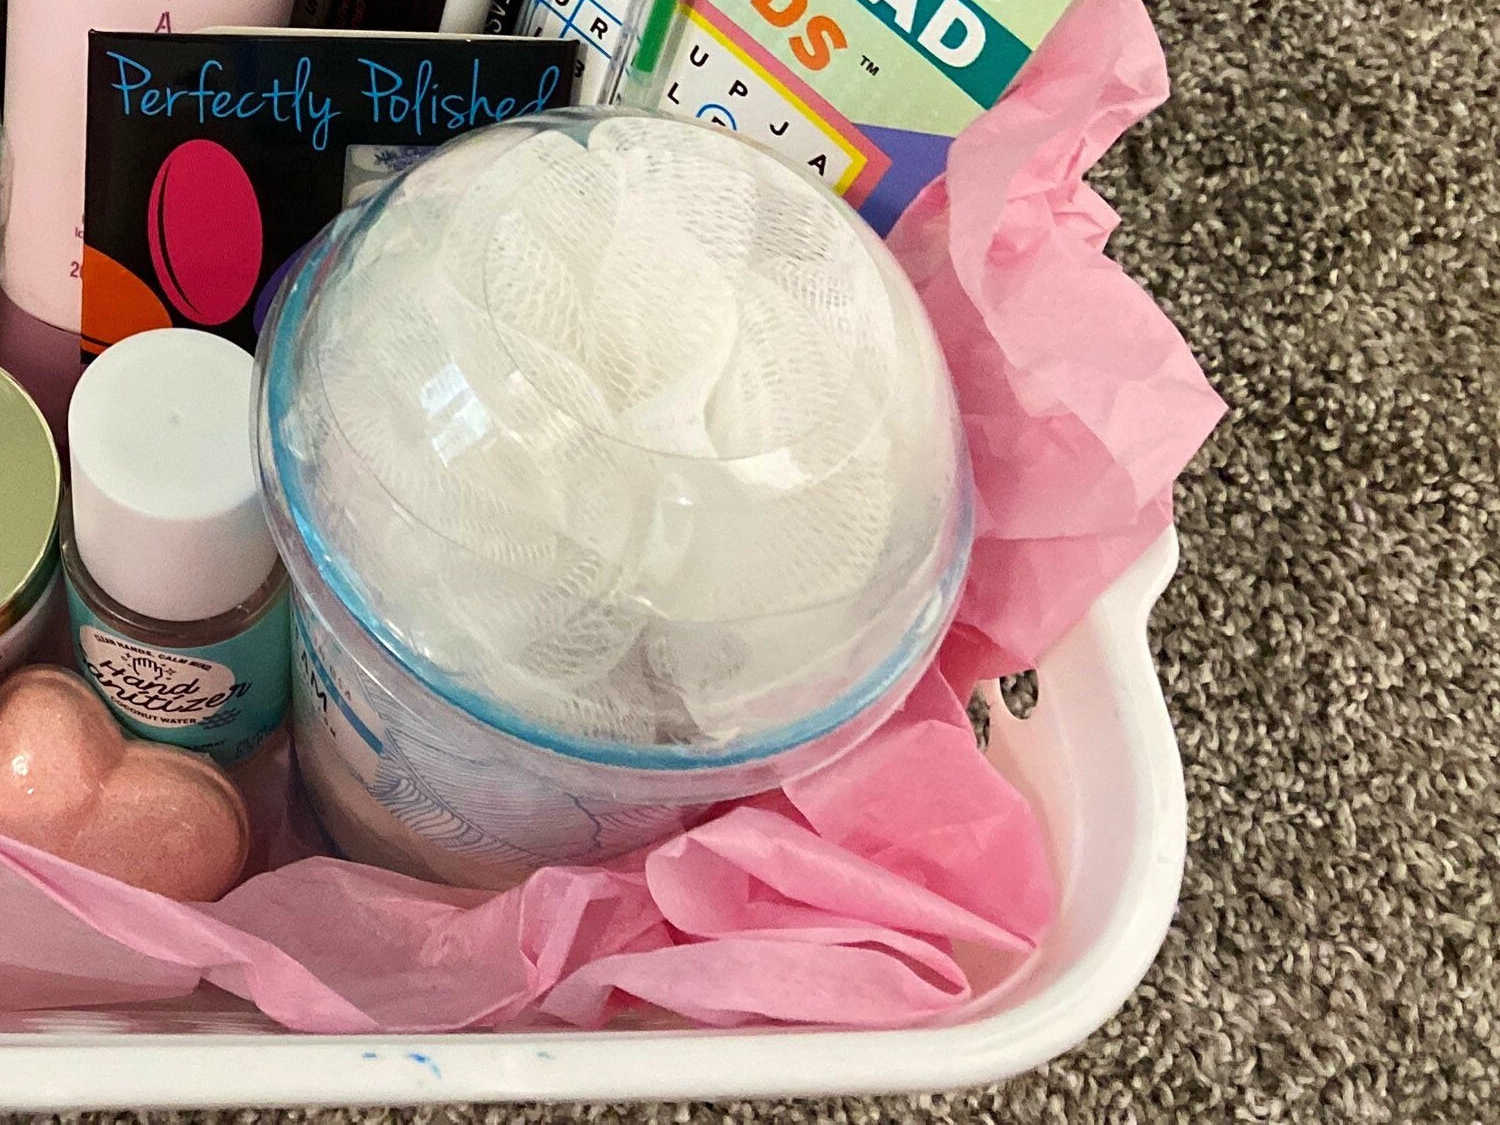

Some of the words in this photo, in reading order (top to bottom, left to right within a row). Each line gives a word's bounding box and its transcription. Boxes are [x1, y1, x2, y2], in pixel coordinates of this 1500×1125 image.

[106, 50, 342, 151] Perfectly
[357, 58, 561, 136] Polished
[99, 659, 200, 695] Hand
[110, 695, 158, 722] COCONUT
[160, 716, 197, 725] WATER
